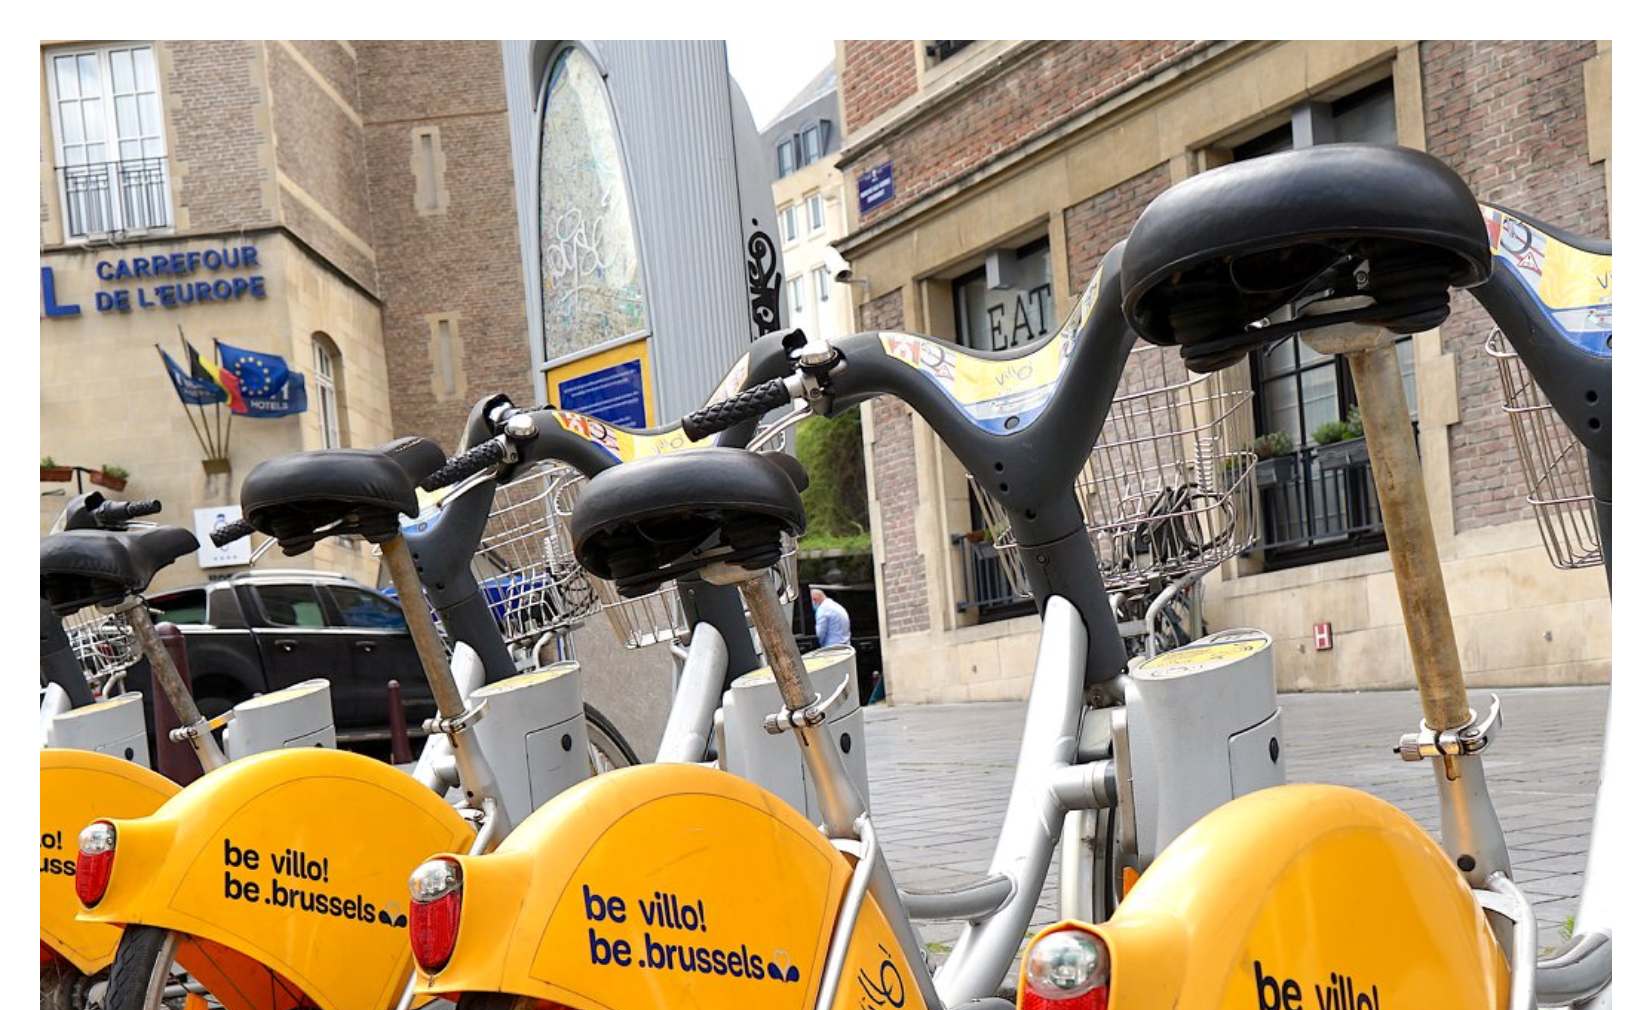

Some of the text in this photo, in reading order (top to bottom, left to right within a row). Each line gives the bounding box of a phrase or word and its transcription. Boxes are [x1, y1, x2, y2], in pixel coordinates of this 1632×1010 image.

[96, 246, 259, 280] CARREFOUR
[95, 276, 266, 312] DE L'EUROPE
[987, 283, 1050, 351] EAT
[1314, 623, 1329, 649] H
[224, 838, 329, 883] be villo!
[224, 871, 260, 902] be
[582, 884, 707, 932] be villo!
[588, 927, 632, 967] be
